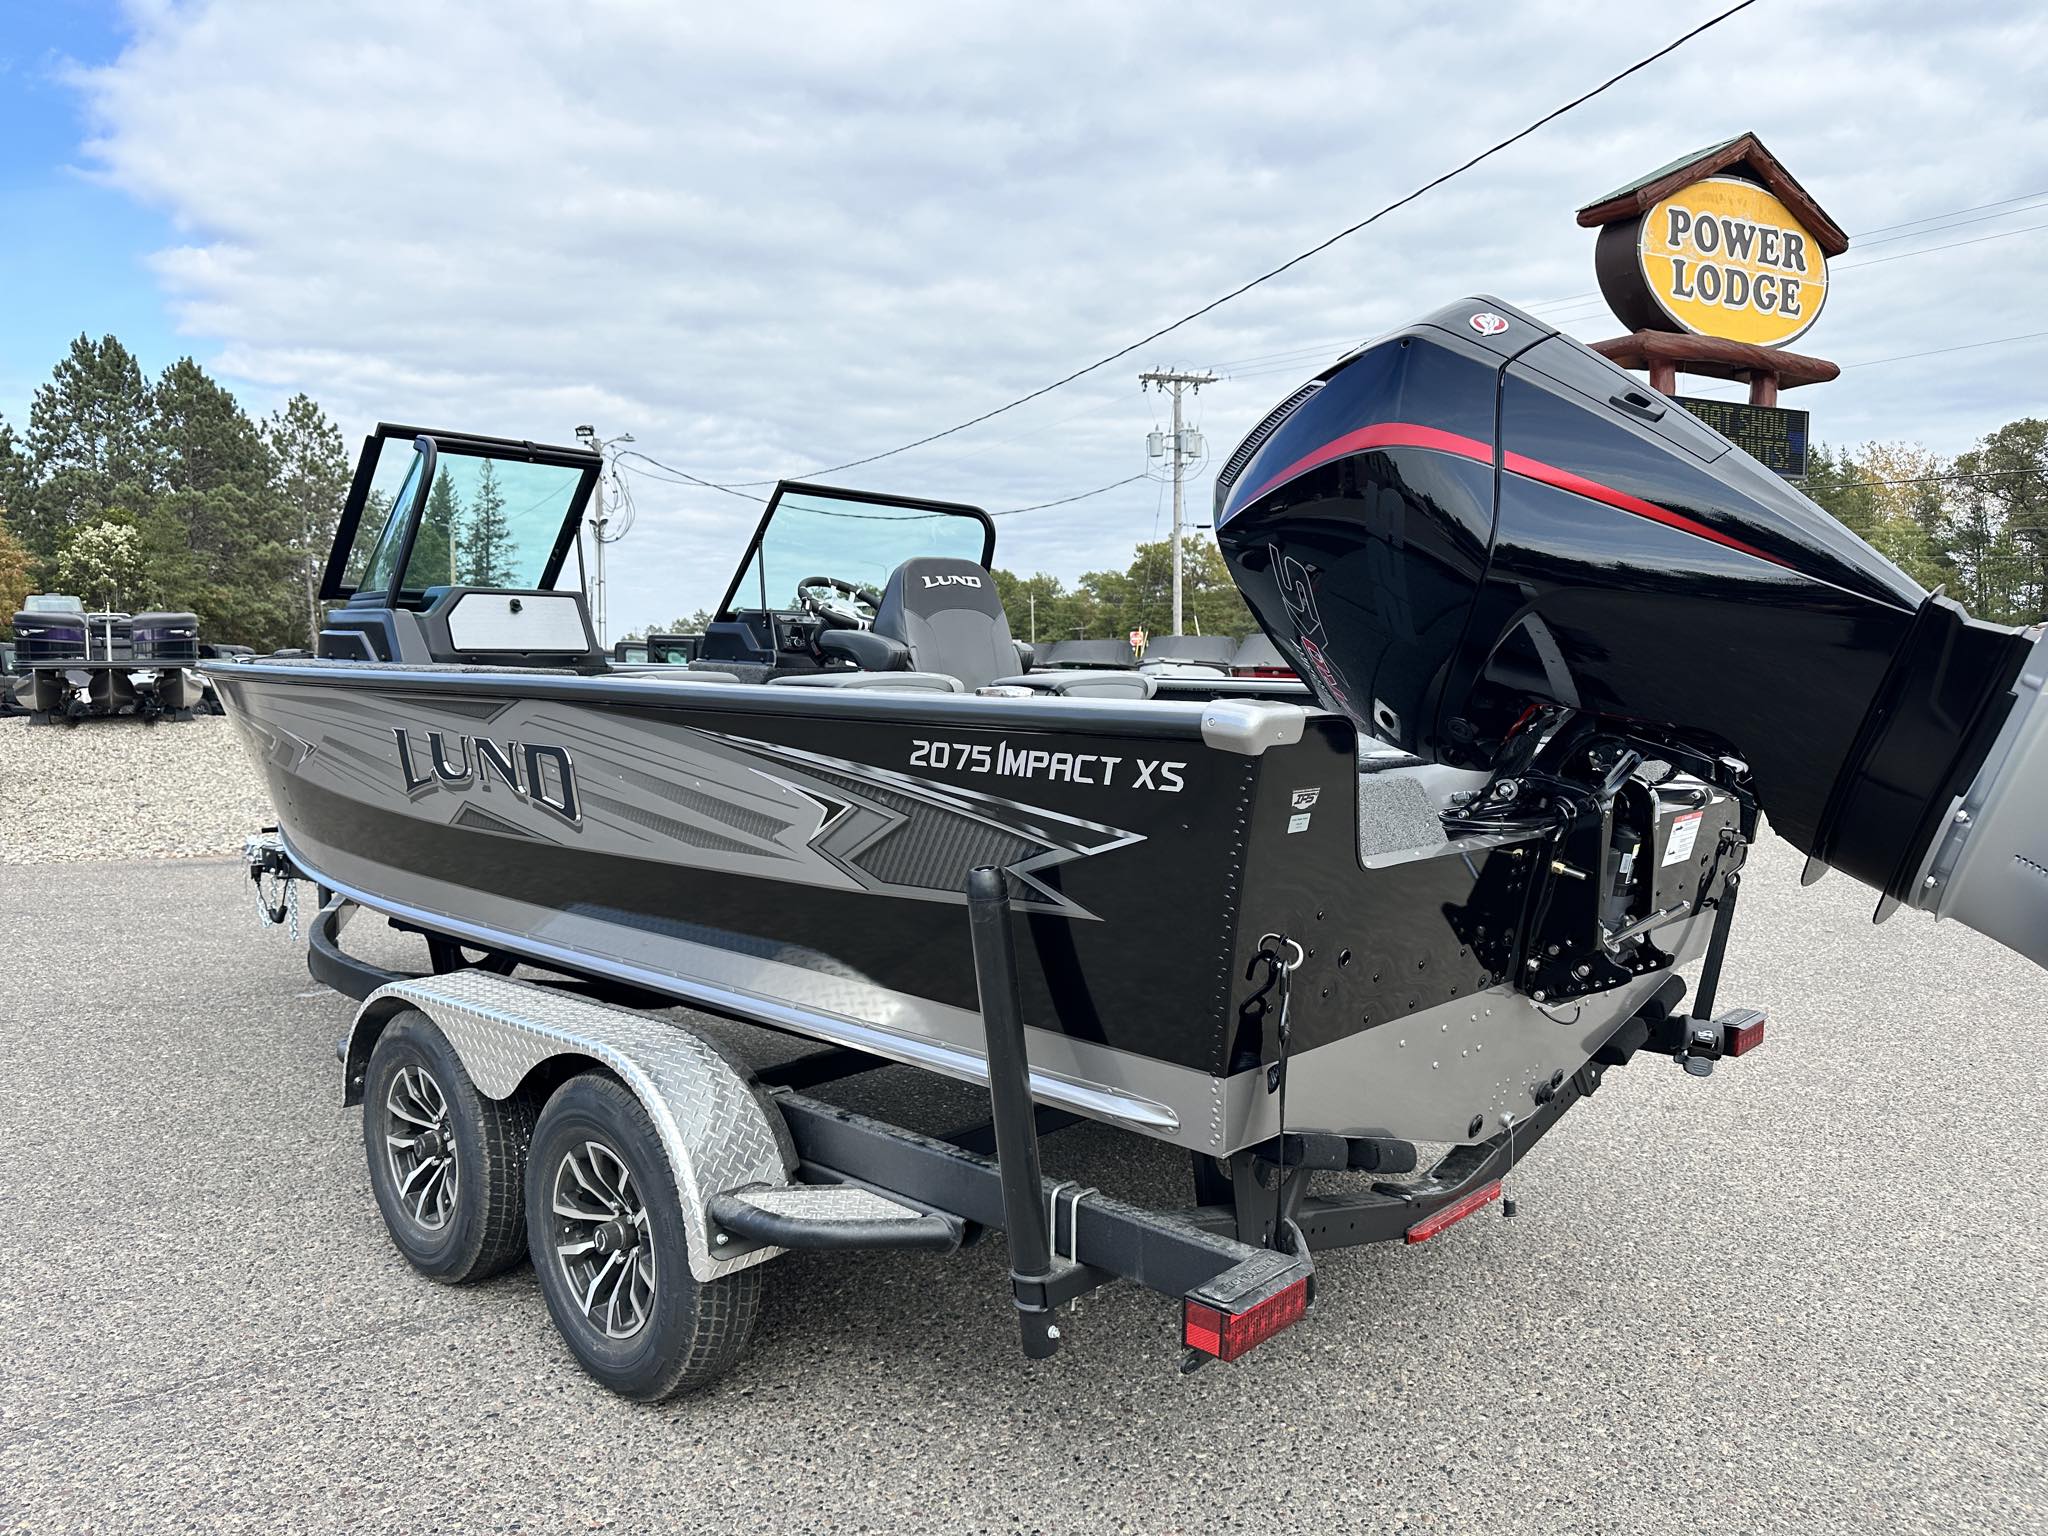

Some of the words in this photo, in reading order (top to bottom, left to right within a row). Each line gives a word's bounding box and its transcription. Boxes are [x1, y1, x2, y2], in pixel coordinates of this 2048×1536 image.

[1667, 207, 1806, 272] POWER
[1672, 258, 1801, 316] LODGE
[1739, 408, 1788, 440] SHOW
[921, 575, 982, 589] LUND
[391, 726, 583, 826] LUND
[909, 739, 992, 773] 2075
[996, 739, 1124, 786] IMPACT
[1131, 758, 1188, 793] XS
